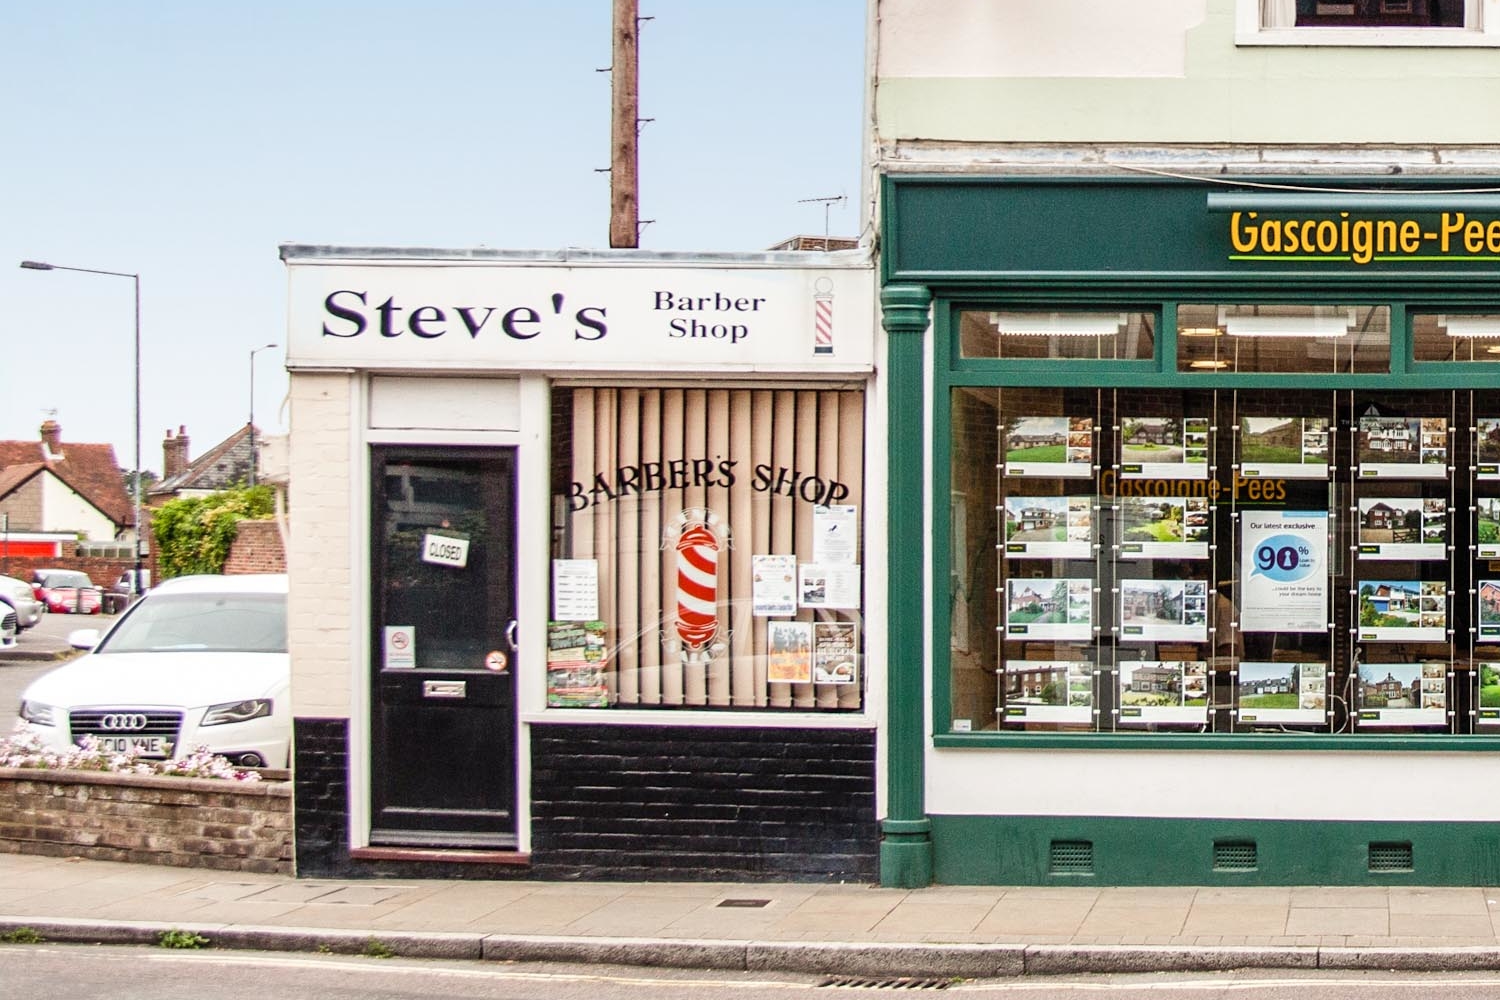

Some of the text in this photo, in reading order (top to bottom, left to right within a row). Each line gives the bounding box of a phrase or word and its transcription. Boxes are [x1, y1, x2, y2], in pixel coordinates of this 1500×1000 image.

[653, 291, 767, 312] Barber
[321, 289, 608, 342] Steve's
[668, 318, 750, 345] Shop
[565, 455, 849, 512] BARBER'S SHOP
[429, 542, 462, 561] CLOSED
